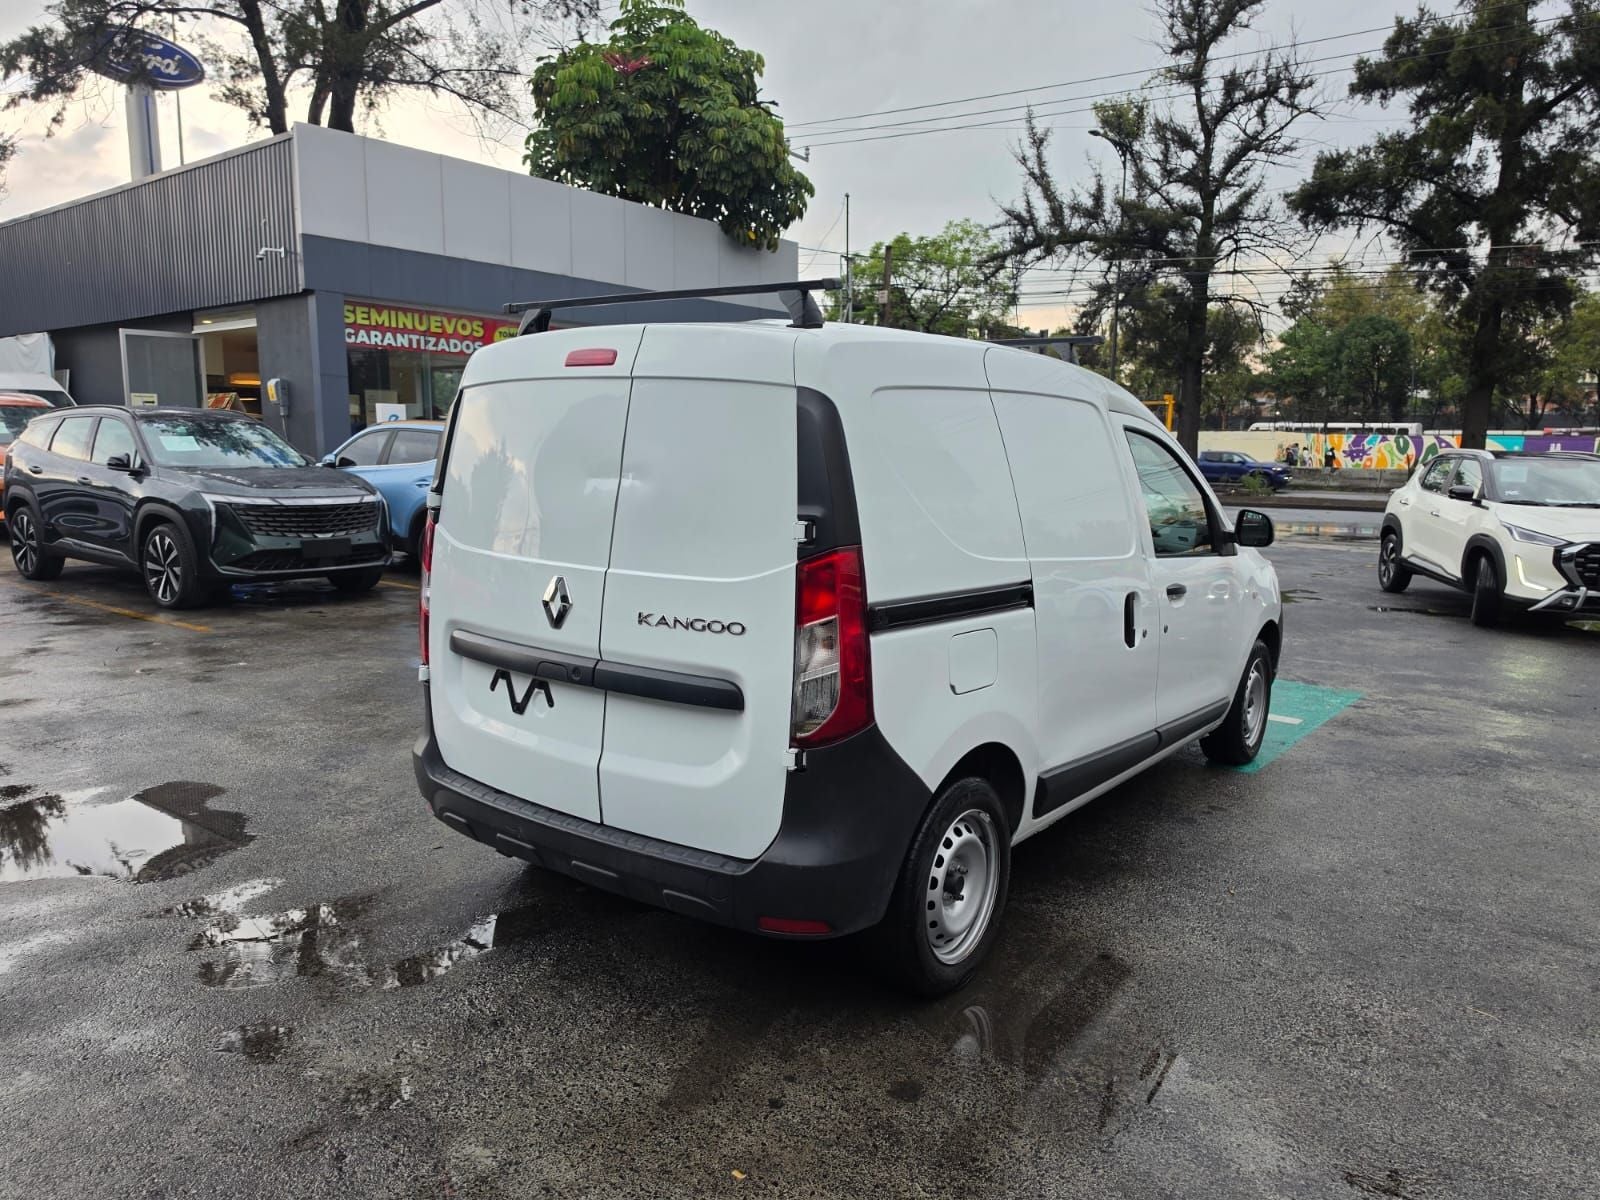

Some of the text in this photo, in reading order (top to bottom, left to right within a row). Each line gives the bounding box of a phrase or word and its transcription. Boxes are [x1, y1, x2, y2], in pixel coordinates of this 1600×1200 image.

[344, 305, 484, 337] SEMINUEVOS
[345, 328, 483, 354] GARANTIZADOS
[638, 612, 746, 636] KANGOO
